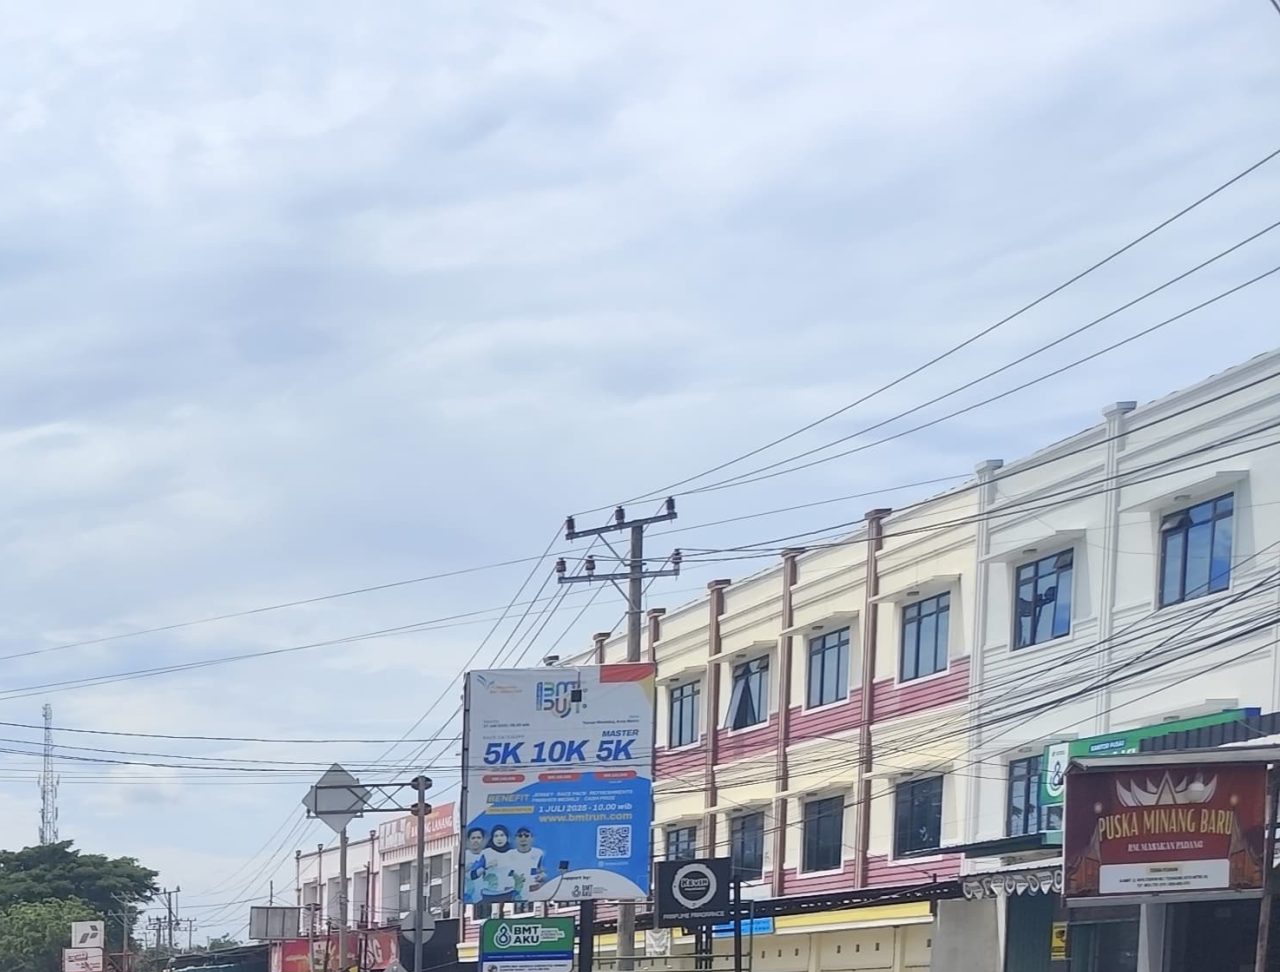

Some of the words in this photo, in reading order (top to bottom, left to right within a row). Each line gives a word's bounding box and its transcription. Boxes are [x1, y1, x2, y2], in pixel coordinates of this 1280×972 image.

[602, 729, 639, 737] MASTER
[483, 742, 524, 765] 5K
[531, 739, 589, 763] 10K
[596, 738, 635, 761] 5K
[545, 805, 565, 813] JULI
[566, 804, 587, 812] 2025
[593, 803, 616, 811] 10.00
[539, 813, 632, 823] www.bmtrun.com
[1098, 811, 1139, 842] PUSKA
[1143, 808, 1196, 834] MINANG
[1200, 808, 1234, 836] BARU
[514, 926, 539, 934] BMT
[513, 936, 539, 944] AKU
